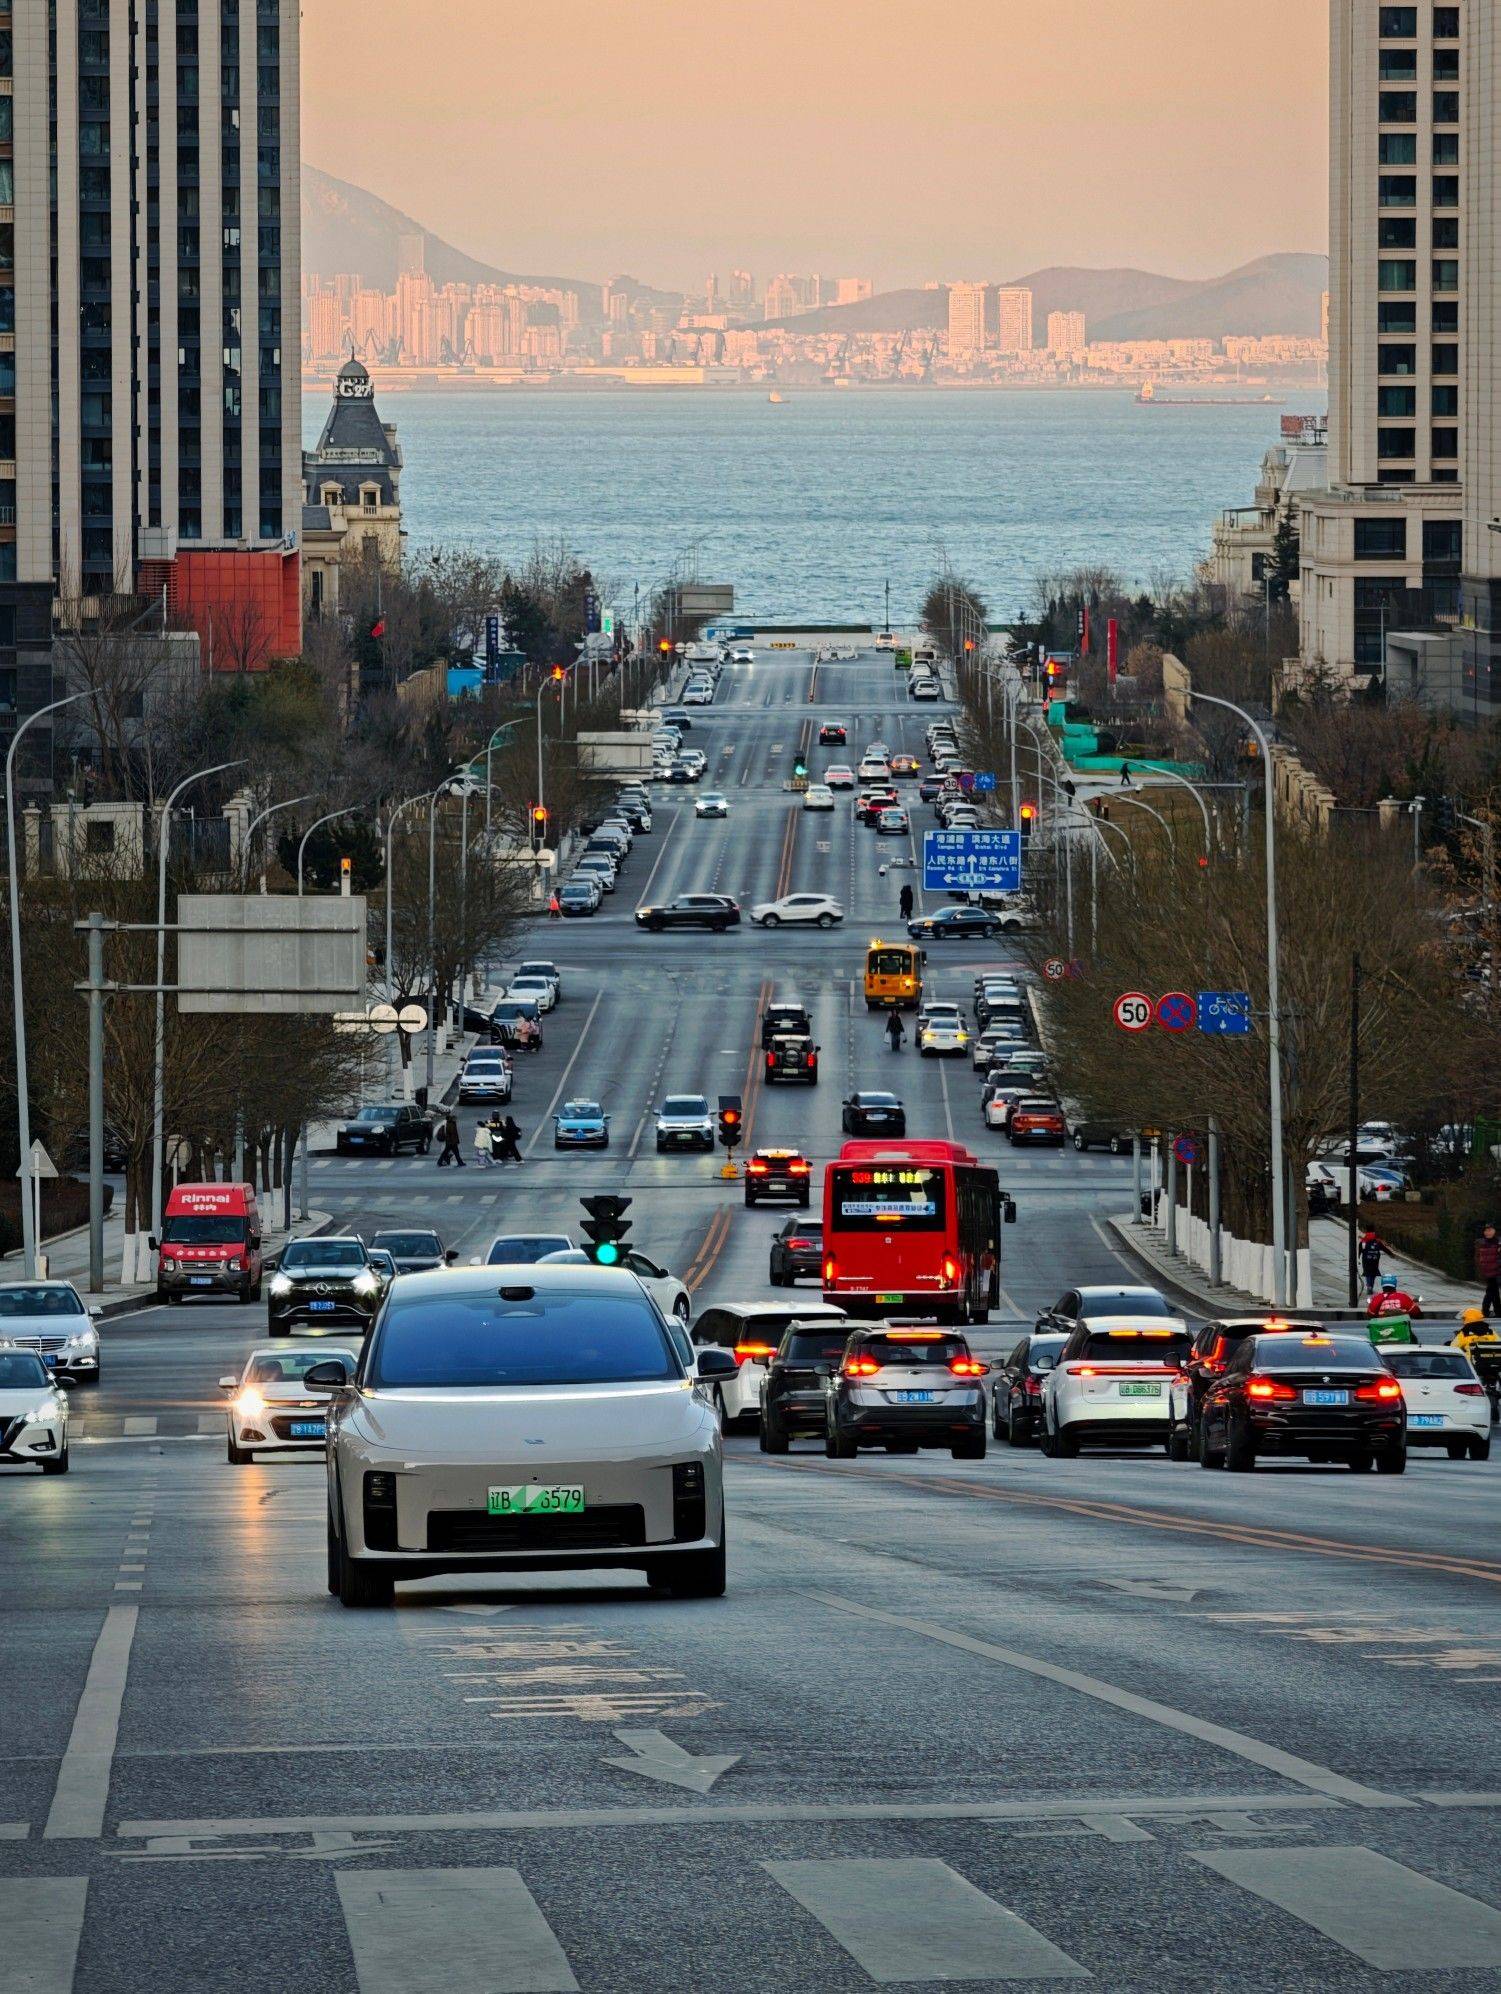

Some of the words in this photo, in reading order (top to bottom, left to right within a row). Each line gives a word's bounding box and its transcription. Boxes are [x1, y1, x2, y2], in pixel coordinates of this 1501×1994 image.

[1048, 964, 1063, 976] 50
[1122, 1002, 1148, 1023] 50
[181, 1194, 230, 1204] Rinnai
